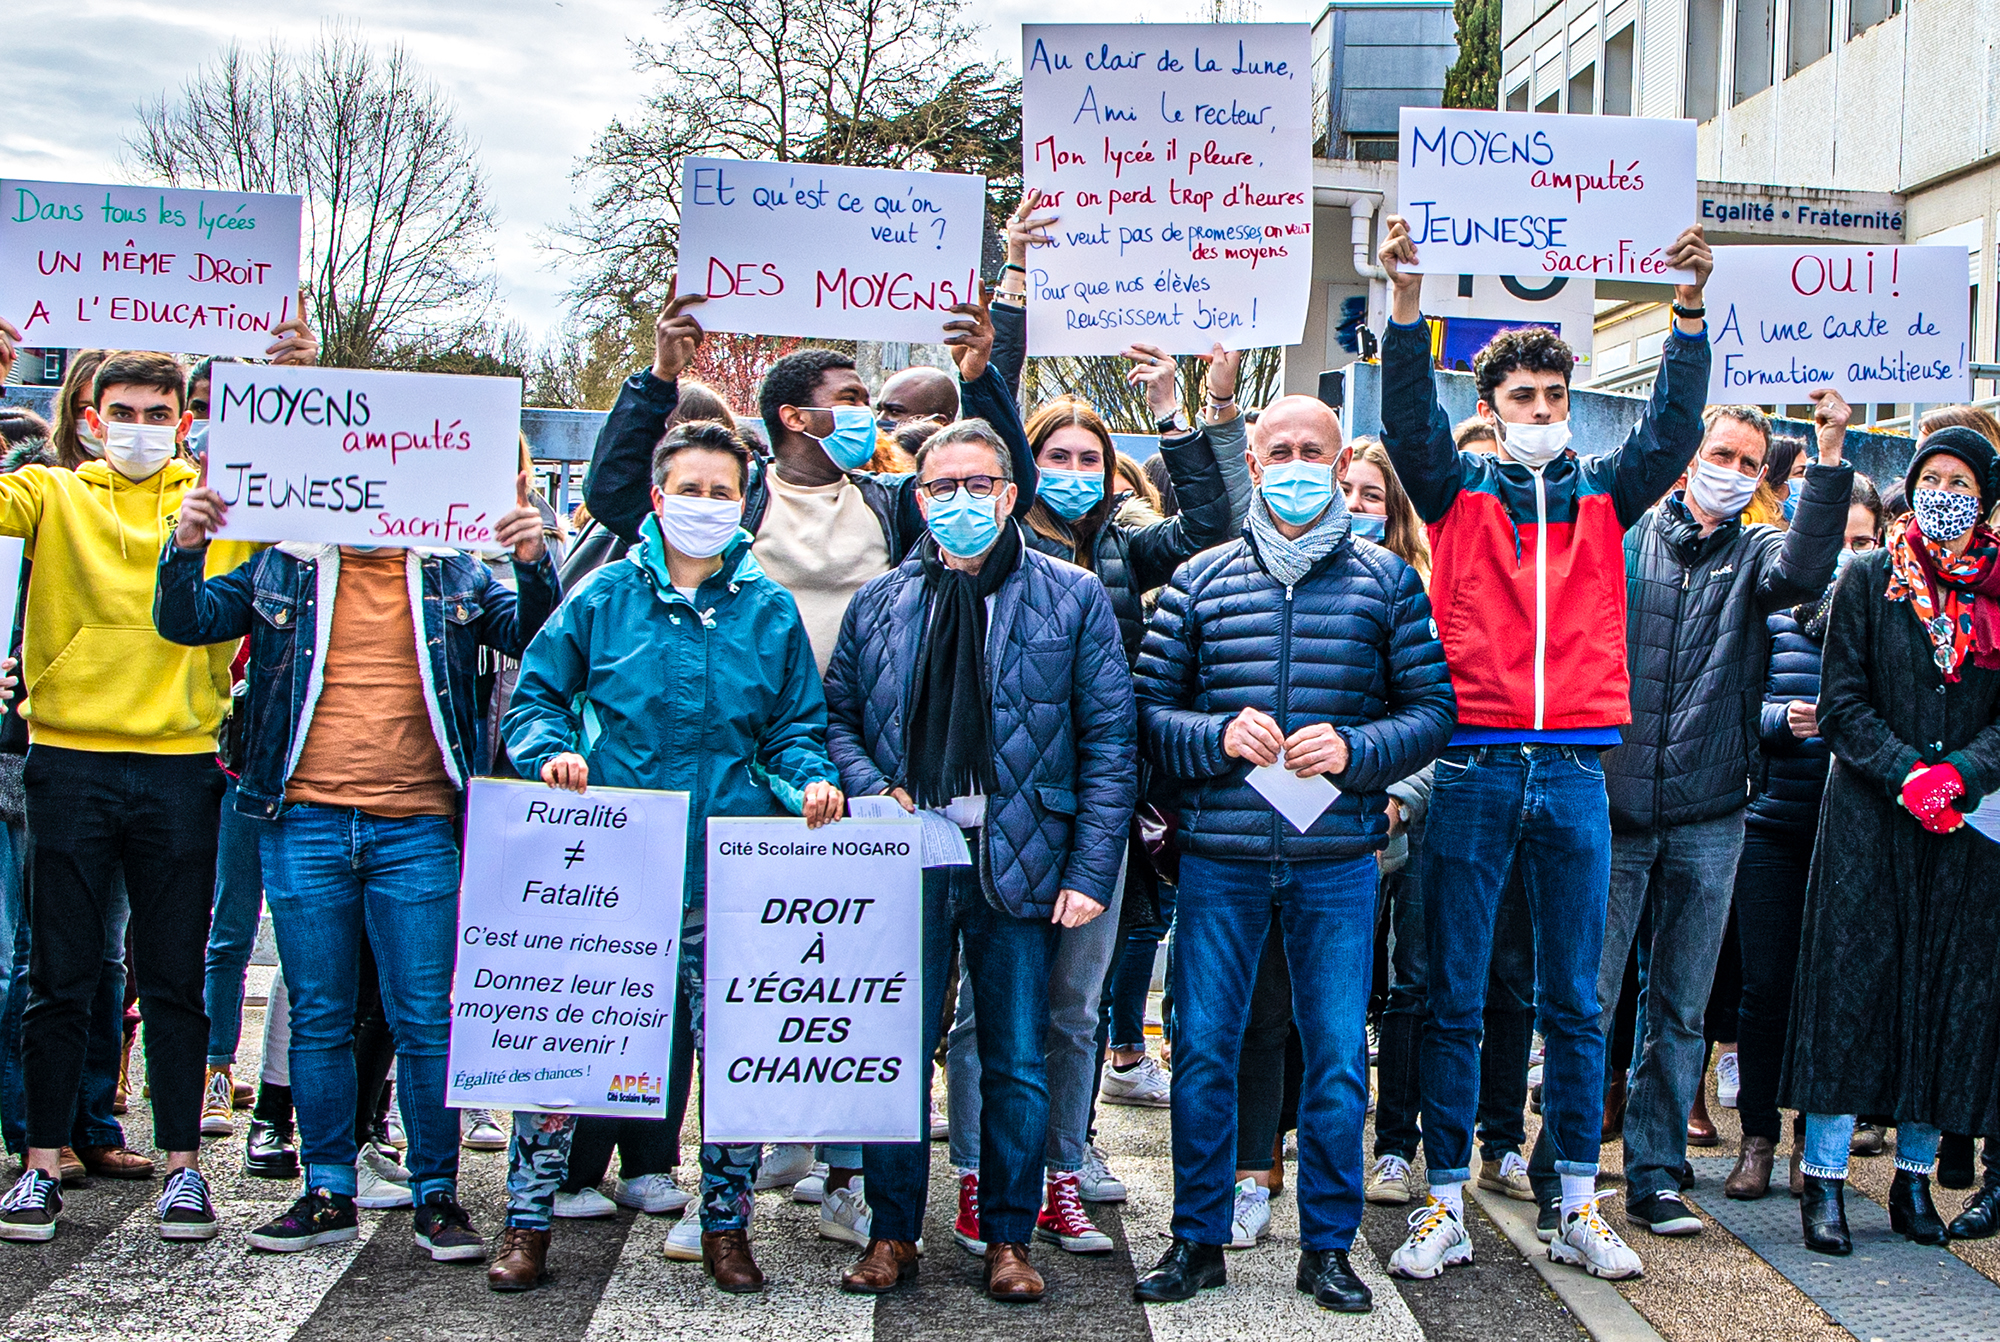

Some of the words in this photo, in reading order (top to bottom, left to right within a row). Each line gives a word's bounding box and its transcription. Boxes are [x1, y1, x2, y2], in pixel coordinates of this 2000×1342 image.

[1030, 38, 1073, 74] Au
[1085, 43, 1146, 71] clair
[1157, 50, 1184, 73] de
[1195, 48, 1223, 73] la
[1073, 85, 1137, 124] Ami
[1162, 91, 1185, 123] le
[1195, 99, 1276, 134] recteur,
[1035, 135, 1086, 172] Mon
[1104, 136, 1155, 178] lycée
[1166, 138, 1177, 161] il
[1412, 126, 1554, 168] MOYENS
[694, 168, 735, 206] Et
[1531, 159, 1644, 204] amputés
[12, 187, 83, 223] Dans
[101, 192, 147, 224] tous
[159, 195, 186, 226] les
[198, 200, 256, 240] lycées
[1076, 191, 1103, 207] on
[1109, 186, 1156, 215] perd
[1222, 182, 1305, 207] d'heures
[1701, 199, 1775, 223] Egalité
[1797, 205, 1902, 231] Fraternité
[871, 222, 918, 244] veut
[1066, 223, 1111, 246] veut
[1119, 225, 1153, 257] pas
[1162, 222, 1184, 243] de
[1410, 201, 1568, 250] JEUNESSE
[38, 250, 81, 275] UN
[103, 239, 176, 275] MÊME
[1192, 242, 1218, 260] des
[1225, 245, 1288, 270] moyens
[706, 256, 784, 299] DES
[1030, 268, 1071, 301] Pour
[1116, 275, 1144, 292] nos
[1153, 269, 1211, 293] élèves
[24, 300, 50, 330] A
[1193, 299, 1243, 330] bien
[1713, 303, 1744, 346] A
[1761, 320, 1813, 343] une
[1908, 312, 1941, 336] de
[1724, 354, 1834, 388] Formation
[220, 383, 370, 427] MOYENS
[343, 419, 471, 465] amputés
[218, 462, 387, 512] JEUNESSE
[526, 801, 628, 829] Ruralité
[719, 841, 753, 856] Cité
[757, 841, 827, 856] Scolaire
[832, 841, 910, 856] NOGARO
[521, 880, 619, 909] Fatalité
[760, 898, 876, 925] DROIT
[463, 926, 519, 947] C'est
[523, 935, 563, 950] une
[569, 933, 658, 956] richesse
[800, 931, 825, 964] À
[473, 968, 564, 993] Donnez
[570, 974, 616, 995] leur
[620, 977, 655, 999] les
[725, 971, 907, 1004] L'ÉGALITÉ
[457, 1001, 549, 1024] moyens
[555, 1004, 584, 1023] de
[591, 1005, 669, 1028] choisir
[778, 1017, 852, 1044] DES
[491, 1029, 538, 1050] leur
[542, 1036, 616, 1055] avenir
[453, 1069, 506, 1091] Égalité
[508, 1069, 531, 1083] des
[534, 1067, 583, 1081] chances
[727, 1056, 903, 1084] CHANCES
[619, 1092, 640, 1103] Scolaire
